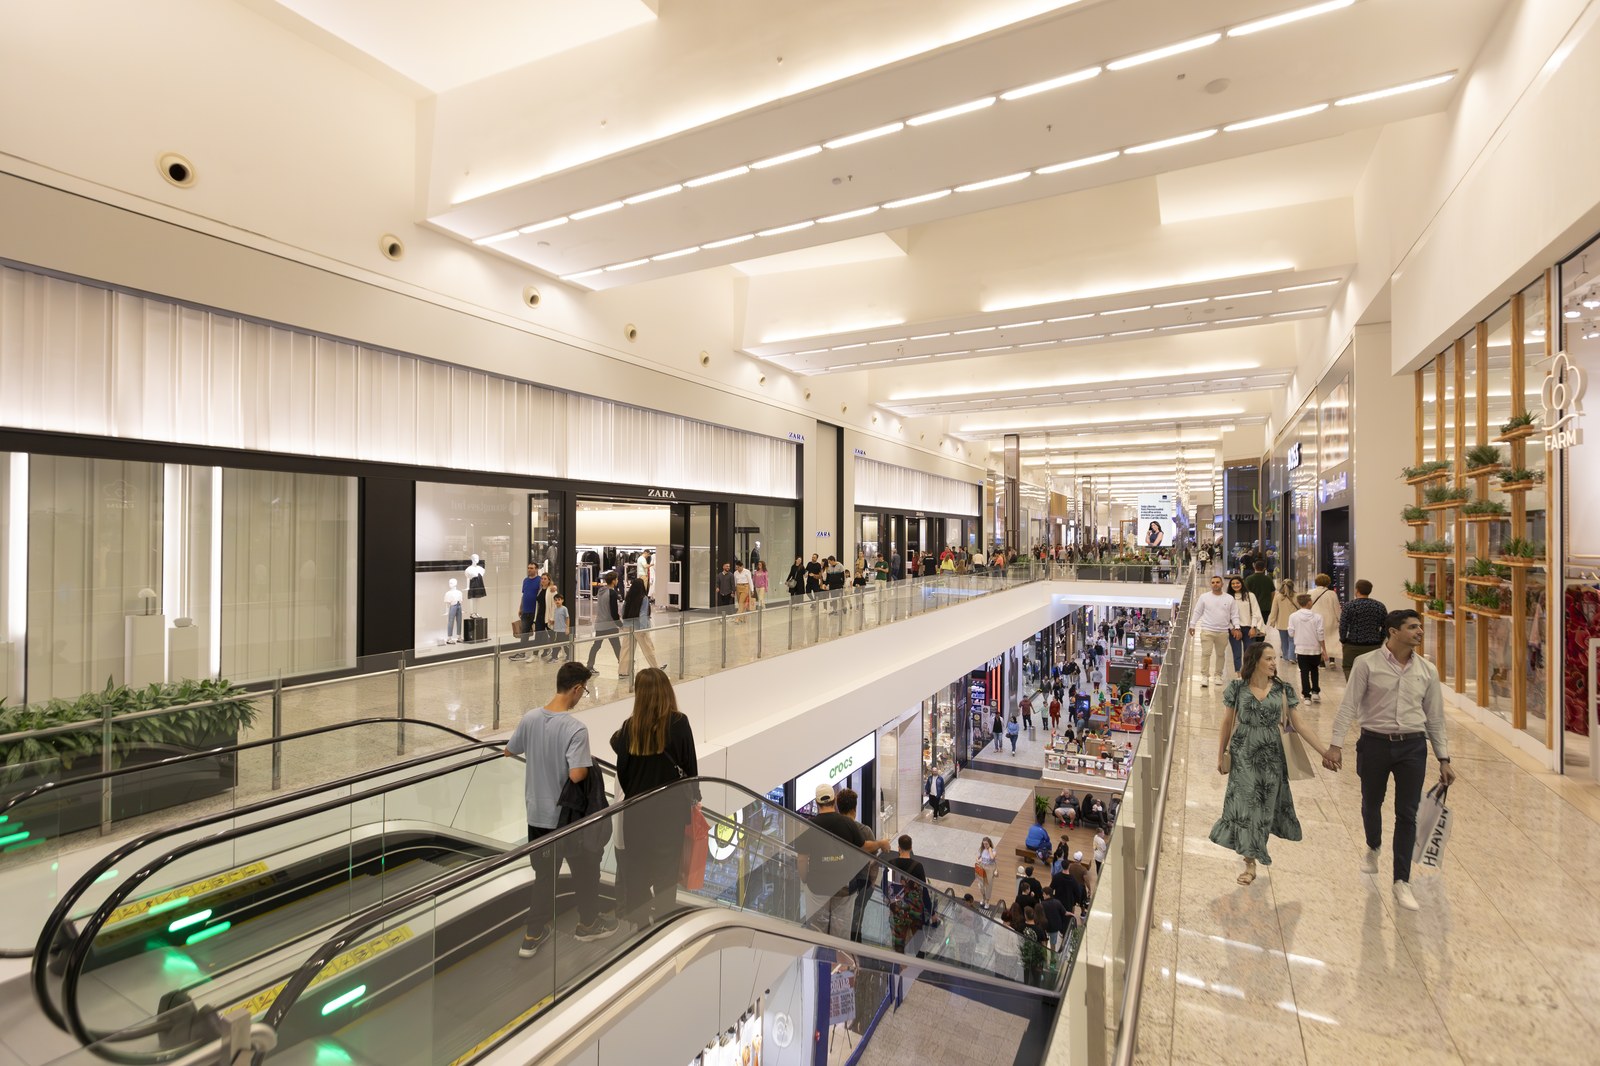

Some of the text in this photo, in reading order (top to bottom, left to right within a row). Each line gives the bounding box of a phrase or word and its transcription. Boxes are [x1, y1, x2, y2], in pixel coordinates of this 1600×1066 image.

[788, 432, 805, 441] ZARA
[1544, 428, 1576, 451] FARM
[854, 448, 867, 456] ZARA
[648, 488, 676, 498] ZARA
[829, 756, 853, 779] crocs
